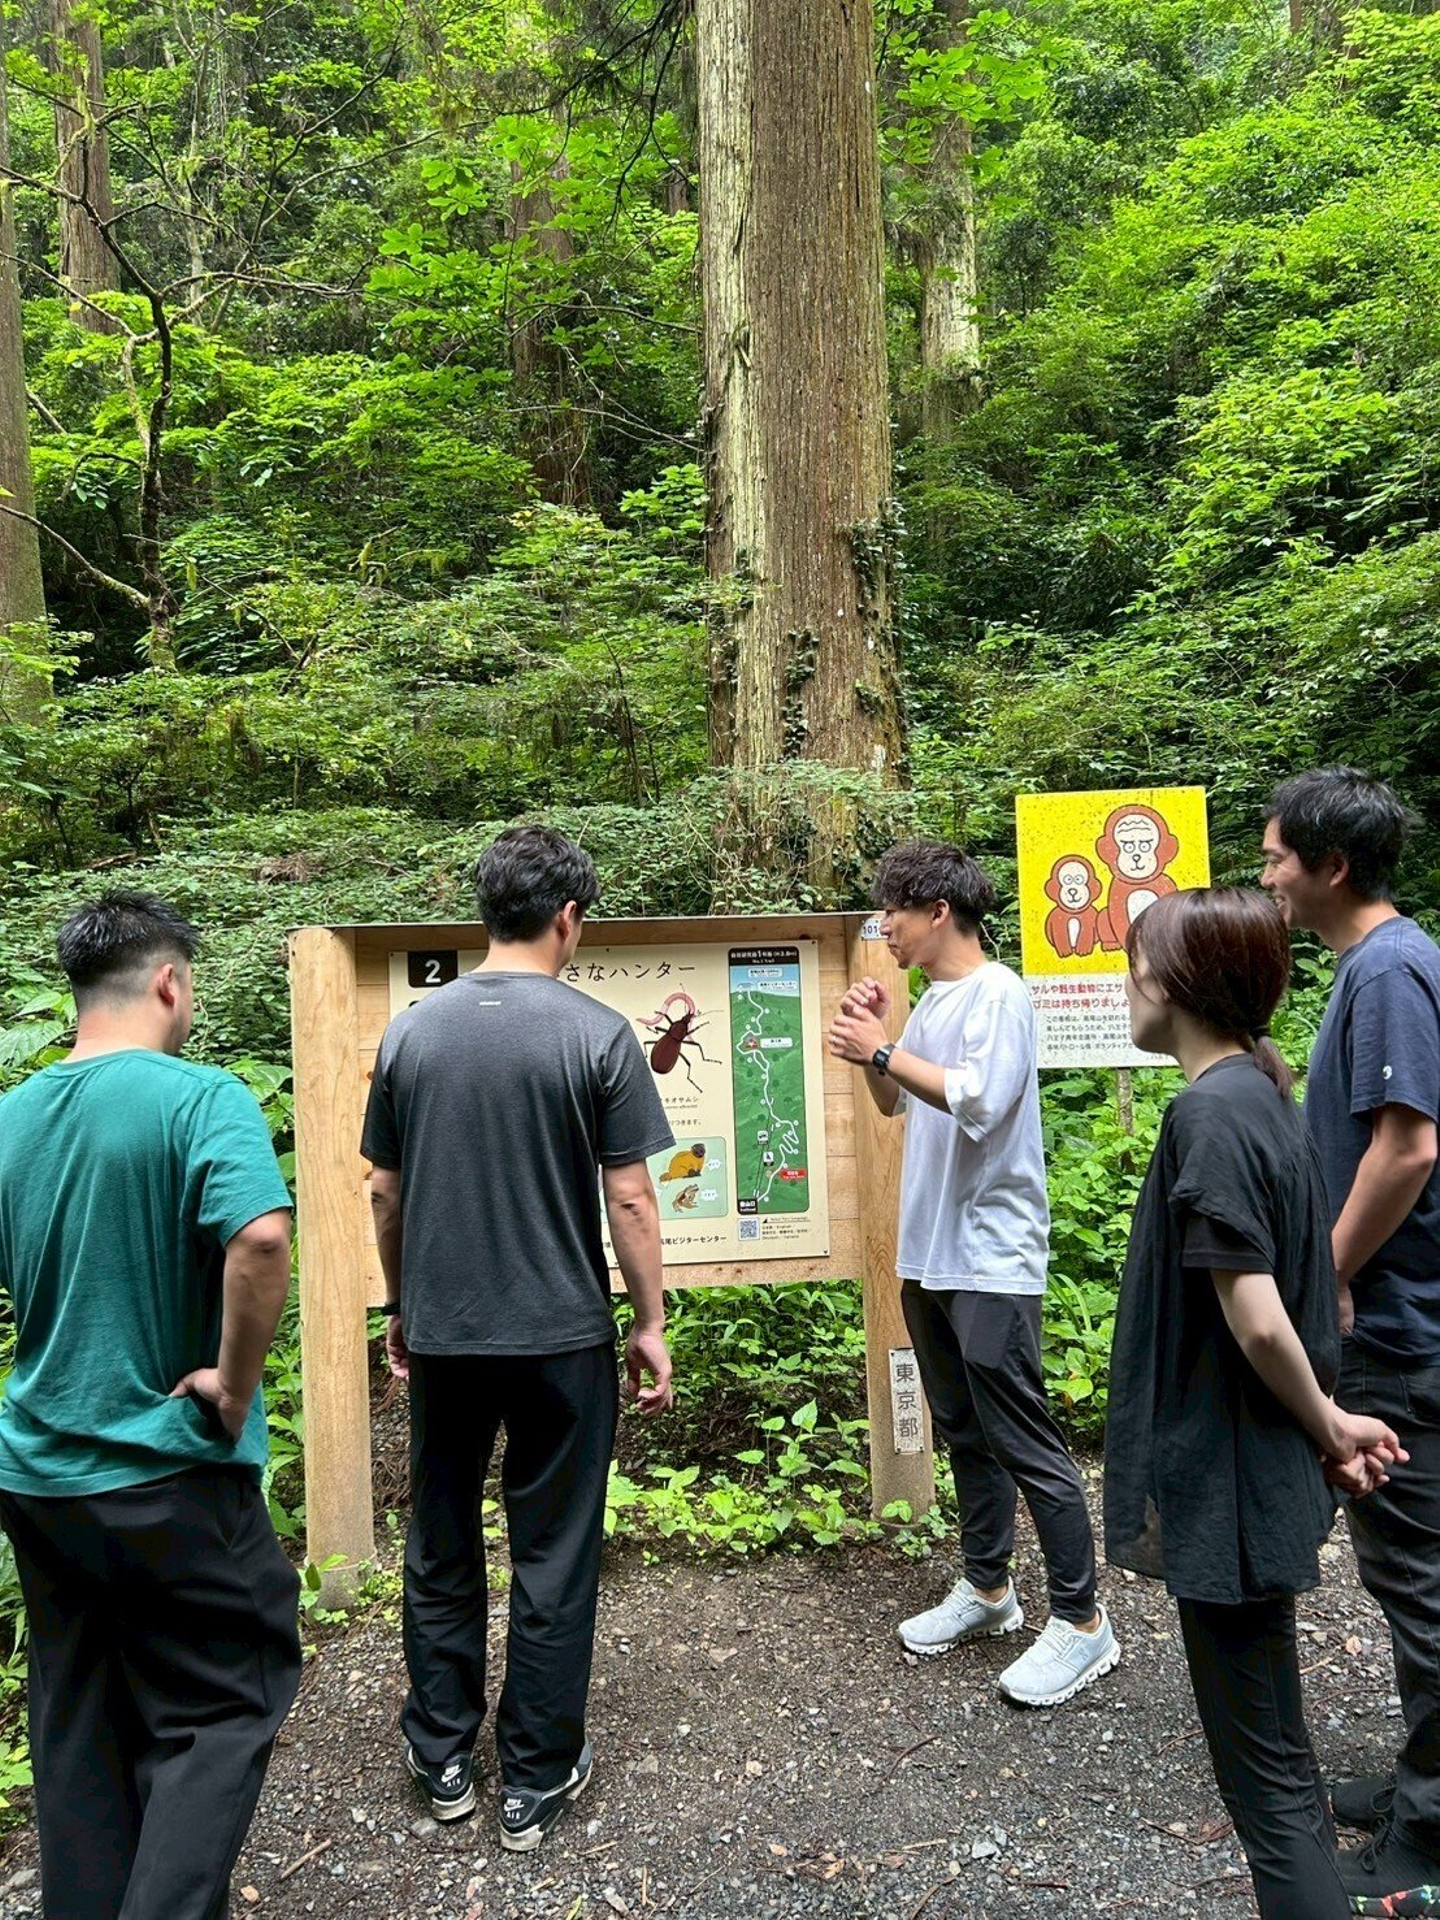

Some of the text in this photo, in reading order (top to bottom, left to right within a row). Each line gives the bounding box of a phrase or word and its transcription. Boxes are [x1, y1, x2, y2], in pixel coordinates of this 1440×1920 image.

[425, 959, 441, 983] 2
[554, 961, 695, 982] さなハンター
[1031, 983, 1123, 995] サルや野生動物にエサ
[896, 1363, 918, 1438] 東京都
[446, 1777, 461, 1788] AIR
[507, 1811, 520, 1820] AIR
